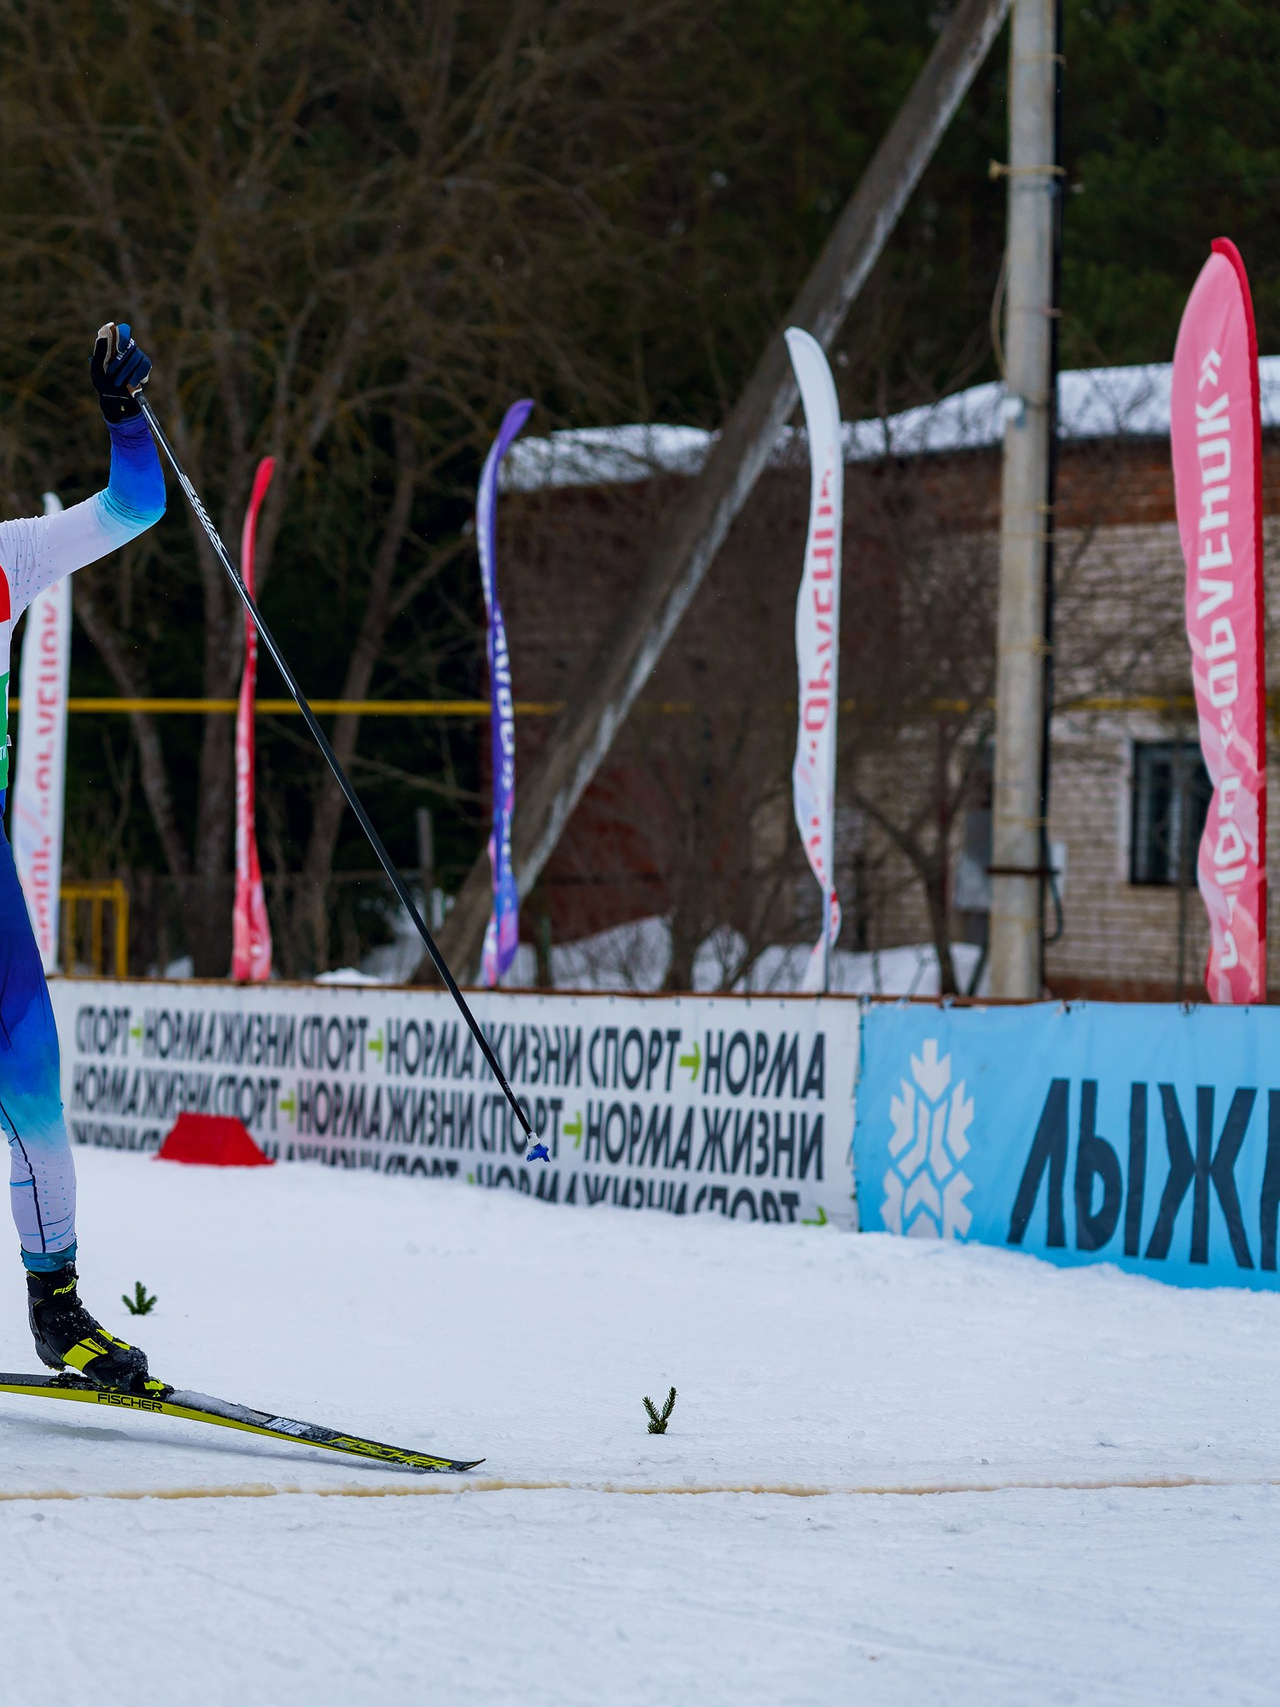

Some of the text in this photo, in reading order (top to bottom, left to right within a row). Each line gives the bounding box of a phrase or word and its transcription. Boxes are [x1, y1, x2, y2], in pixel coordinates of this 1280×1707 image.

[300, 1015, 369, 1073] СПОРТ
[385, 1017, 476, 1080] НОРМА
[479, 1021, 583, 1088] ЖИЗНИ
[587, 1026, 682, 1093] СПОРТ
[702, 1029, 826, 1101] НОРМА
[297, 1079, 382, 1141] НОРМА
[384, 1085, 477, 1150] ЖИЗНИ
[479, 1091, 564, 1159] СПОРТ
[583, 1099, 694, 1172] НОРМА
[695, 1106, 825, 1182] ЖИЗНИ
[1007, 1077, 1280, 1273] ЛЫЖ
[97, 1393, 163, 1413] FISCHER
[328, 1436, 453, 1468] FISCHER
